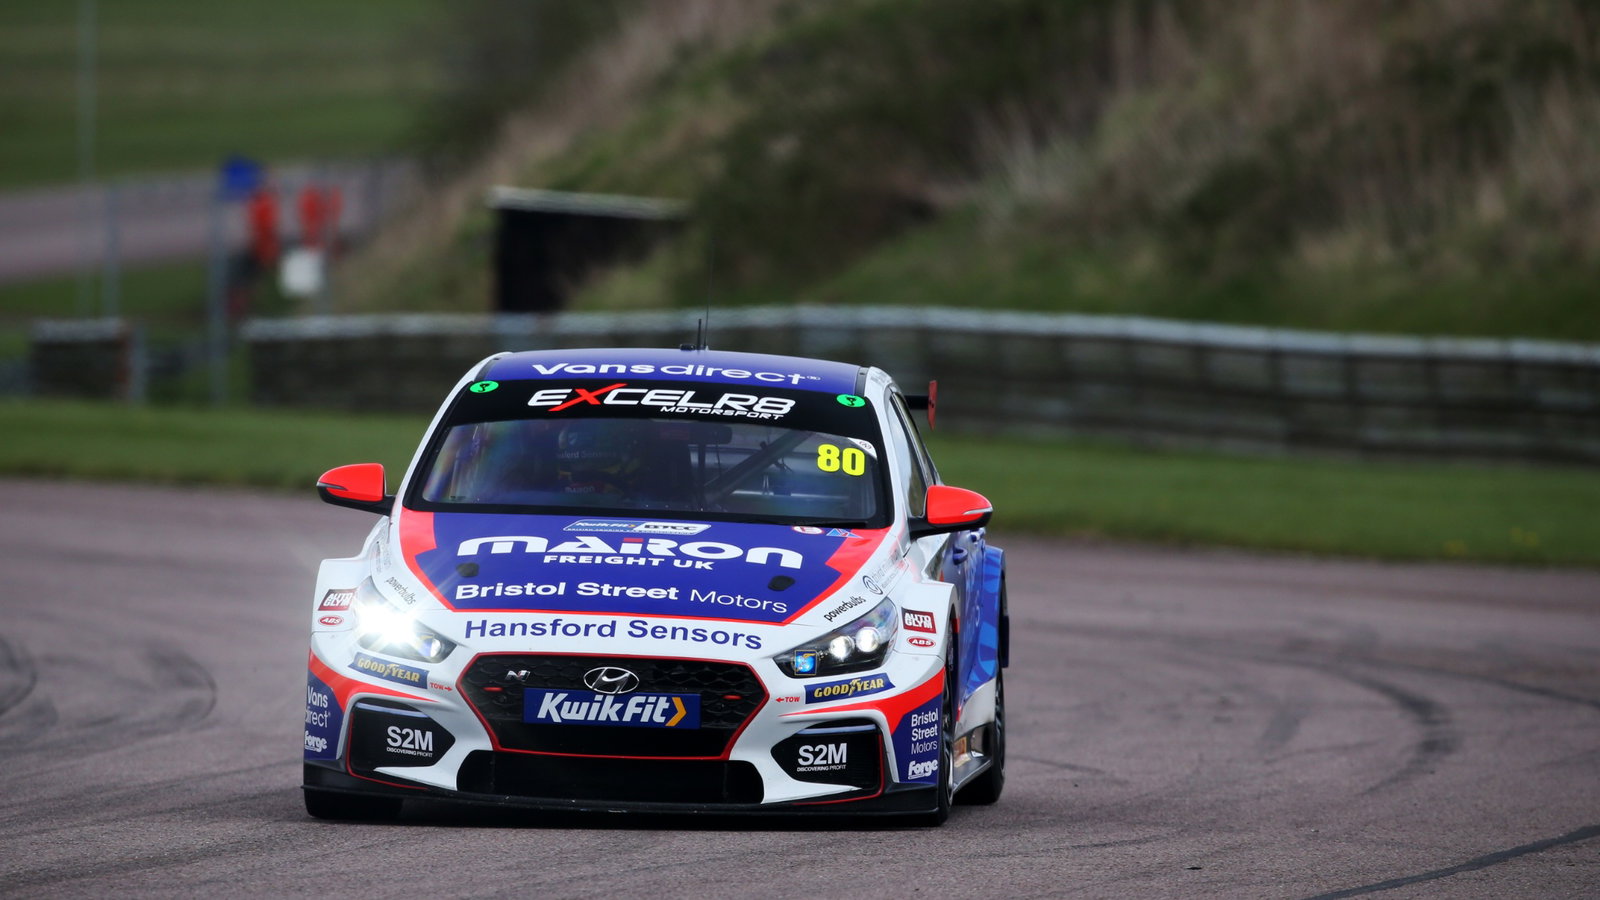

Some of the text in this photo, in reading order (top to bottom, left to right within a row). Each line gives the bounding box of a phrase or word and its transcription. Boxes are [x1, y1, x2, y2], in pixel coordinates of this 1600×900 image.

[527, 383, 796, 415] EXCELR8
[660, 406, 784, 420] MOTORSPORT
[817, 443, 866, 476] 80
[543, 555, 715, 571] FREIGHT UK
[456, 582, 787, 614] Bristol Street Motors
[824, 595, 866, 622] powerbulbs
[465, 619, 762, 650] Hansford Sensors
[307, 685, 328, 708] Vans
[430, 682, 444, 691] TOW
[911, 708, 939, 727] Bristol
[386, 725, 433, 752] S2M
[911, 724, 938, 742] Street
[797, 742, 847, 766] S2M
[911, 740, 938, 755] Motors
